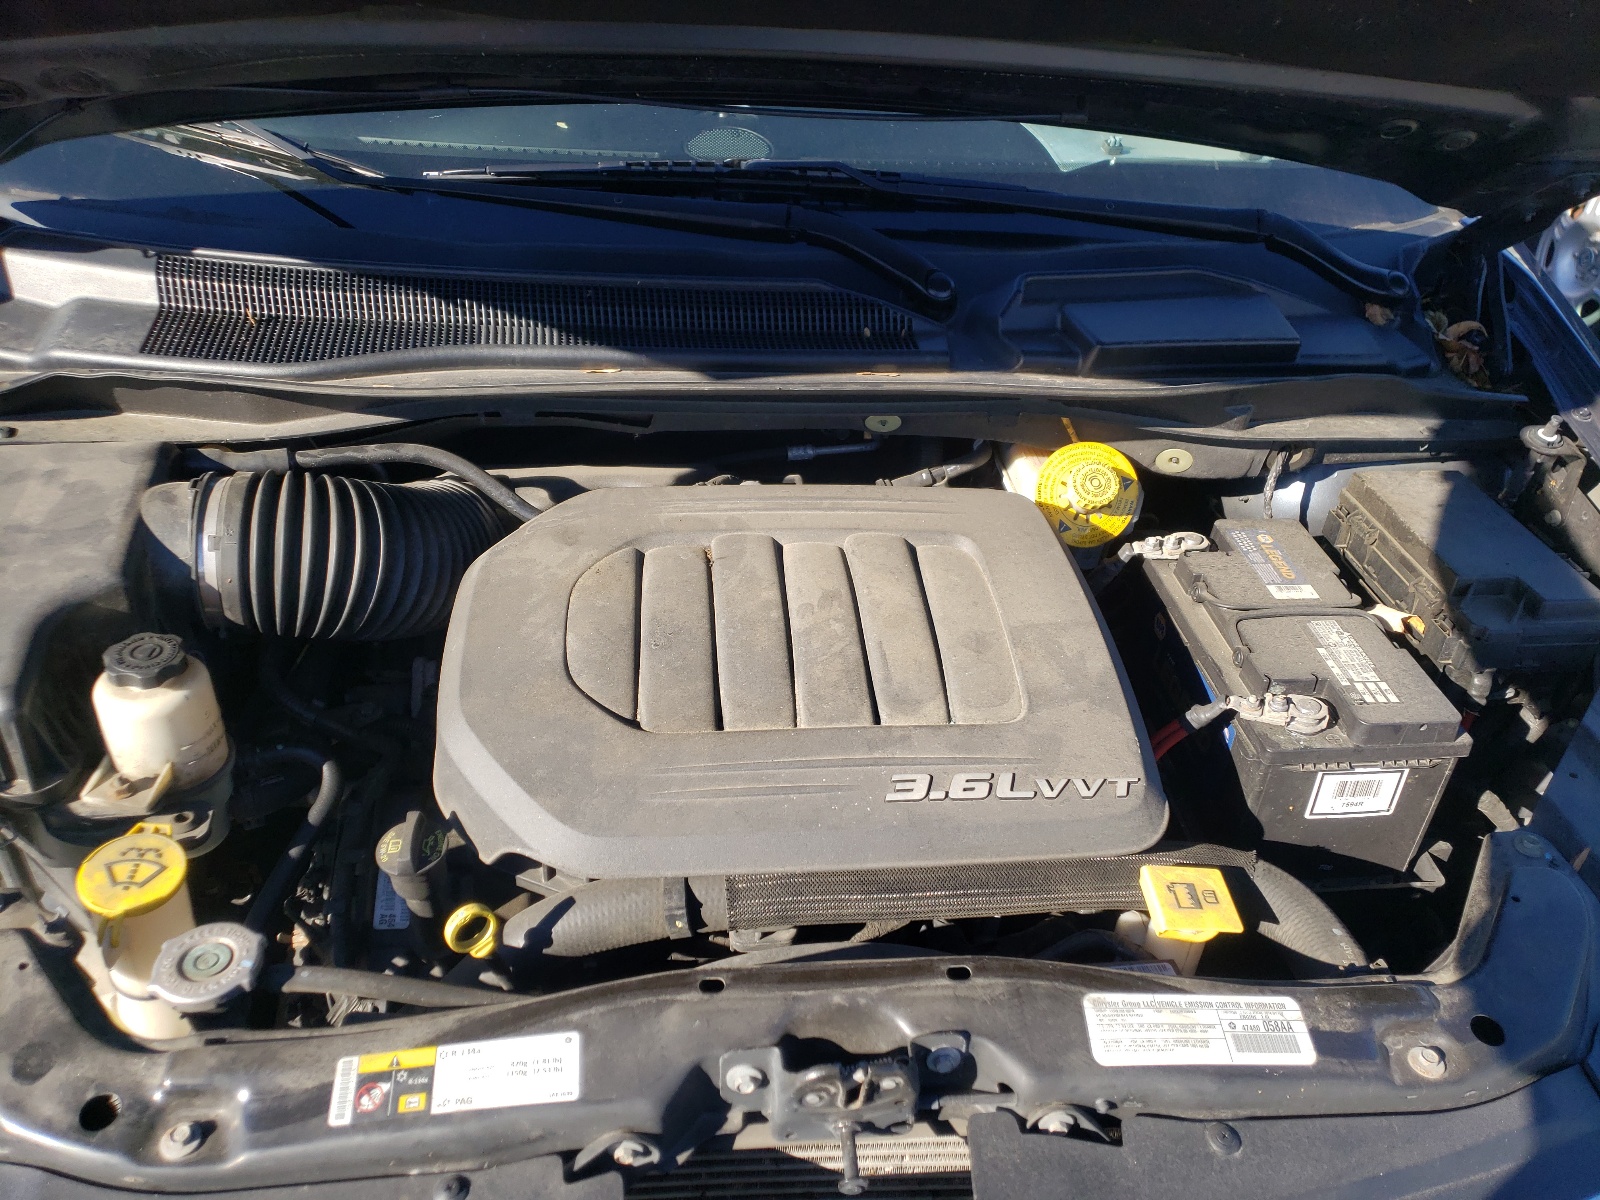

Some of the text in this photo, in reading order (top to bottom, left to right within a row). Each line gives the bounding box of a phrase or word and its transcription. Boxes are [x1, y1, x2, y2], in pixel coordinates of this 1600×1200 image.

[1261, 545, 1296, 579] LEGEND
[1121, 1000, 1141, 1010] Group
[1184, 1001, 1214, 1009] EMISSION
[1215, 1001, 1243, 1009] CONTROL
[1244, 1002, 1287, 1010] INFORMATION
[1263, 1020, 1294, 1033] 058AA
